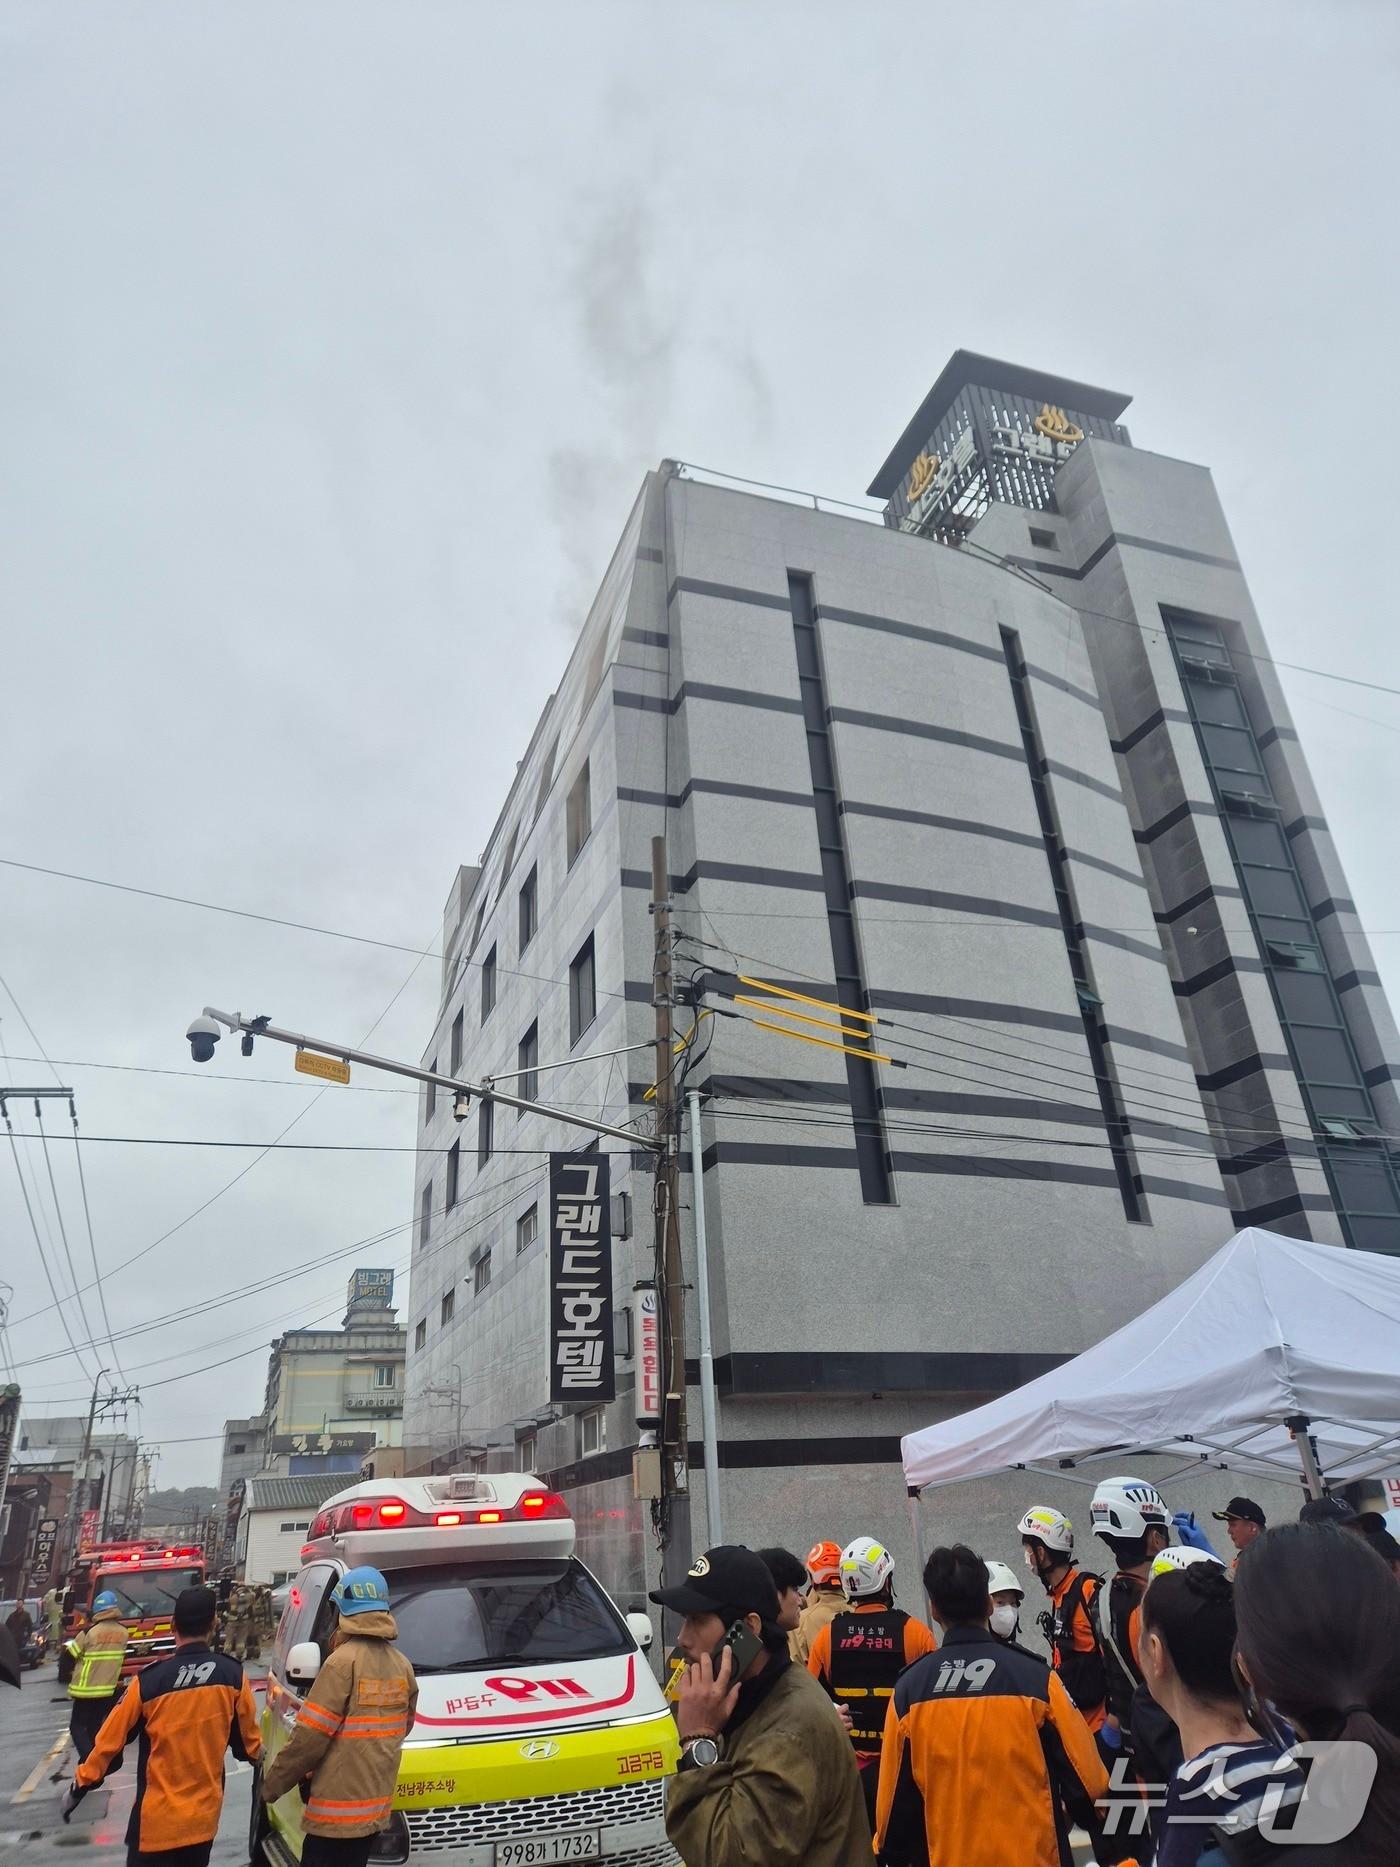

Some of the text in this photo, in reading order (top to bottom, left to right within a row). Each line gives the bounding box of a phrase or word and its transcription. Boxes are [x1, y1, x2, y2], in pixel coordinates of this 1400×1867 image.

[358, 1272, 391, 1286] 빙그레
[555, 1164, 607, 1388] 그랜드호텔
[361, 1286, 388, 1297] MOTEL
[840, 1634, 865, 1648] 119
[173, 1661, 216, 1688] 119
[933, 1658, 996, 1692] 119
[396, 1778, 456, 1798] 전남광주소방
[502, 1834, 594, 1866] 998가 1732
